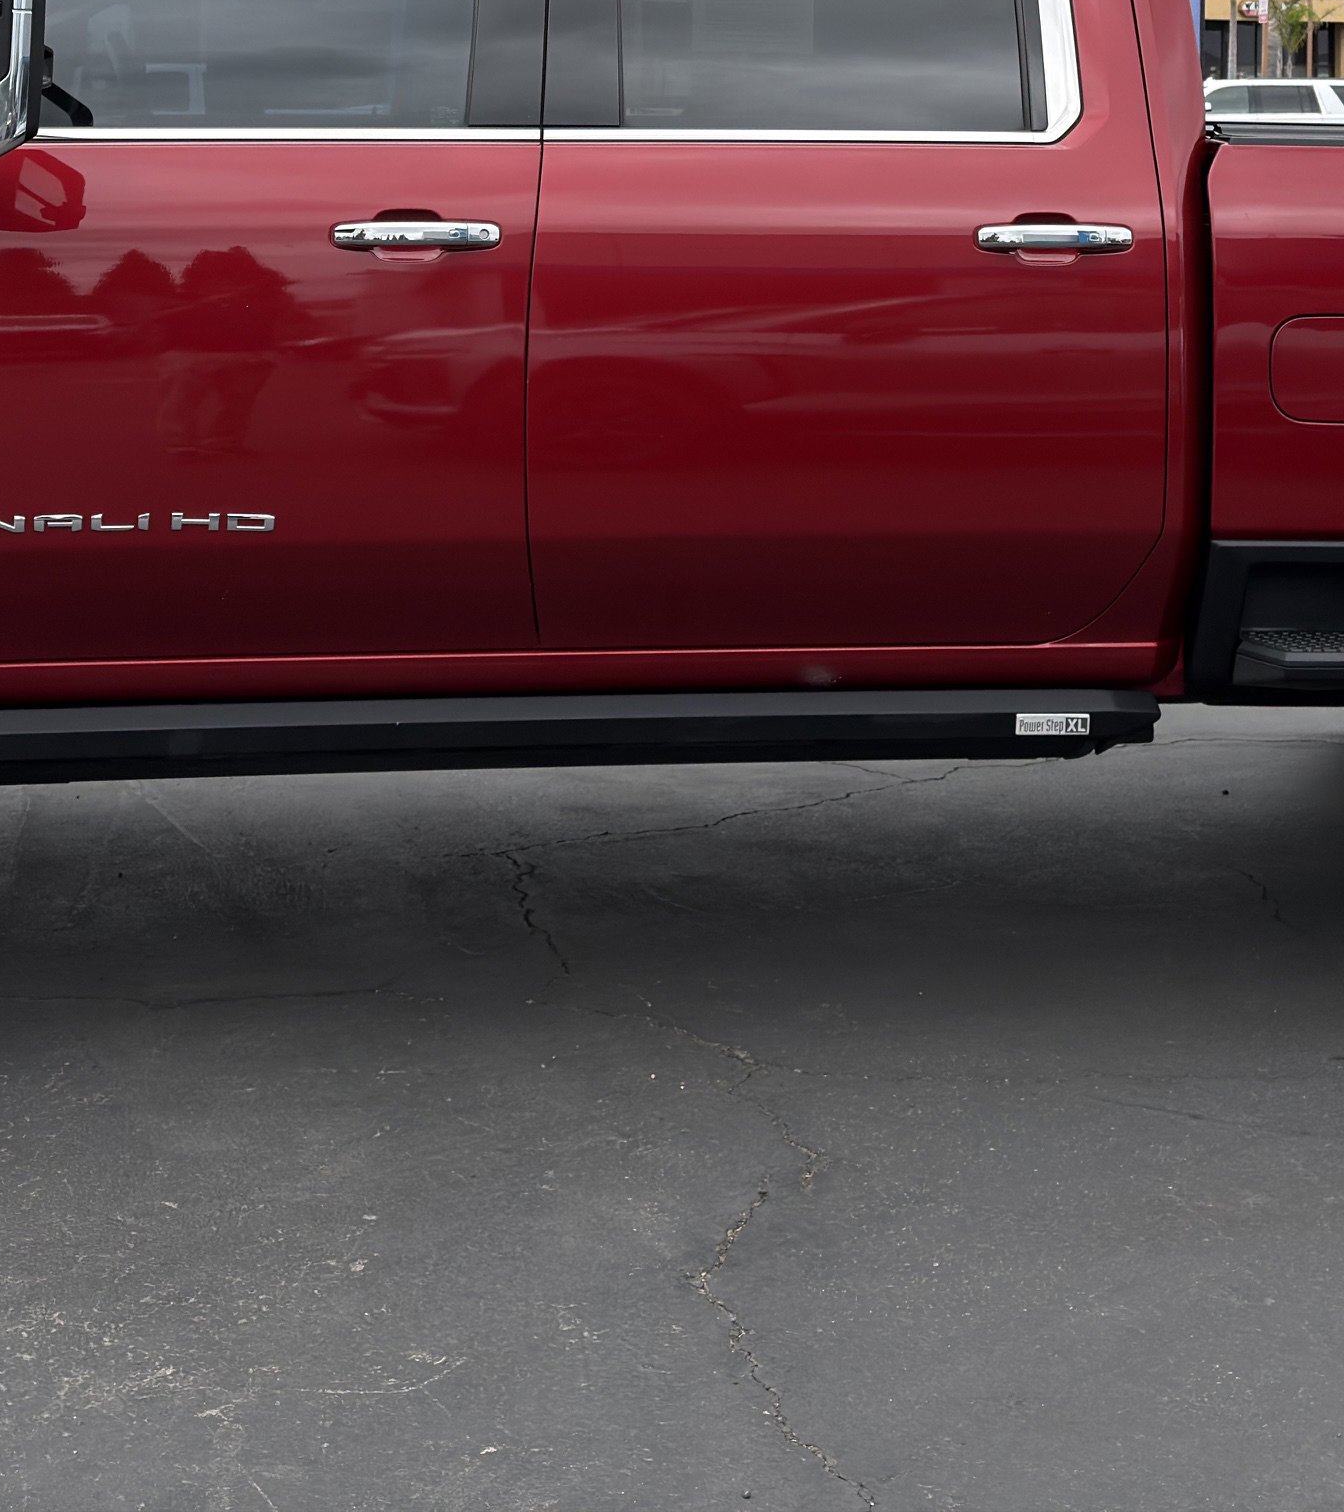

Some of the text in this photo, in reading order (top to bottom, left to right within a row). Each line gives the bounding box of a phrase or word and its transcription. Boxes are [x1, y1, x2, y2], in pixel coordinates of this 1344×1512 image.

[171, 512, 276, 533] HD
[1019, 718, 1087, 734] Power Step XL
